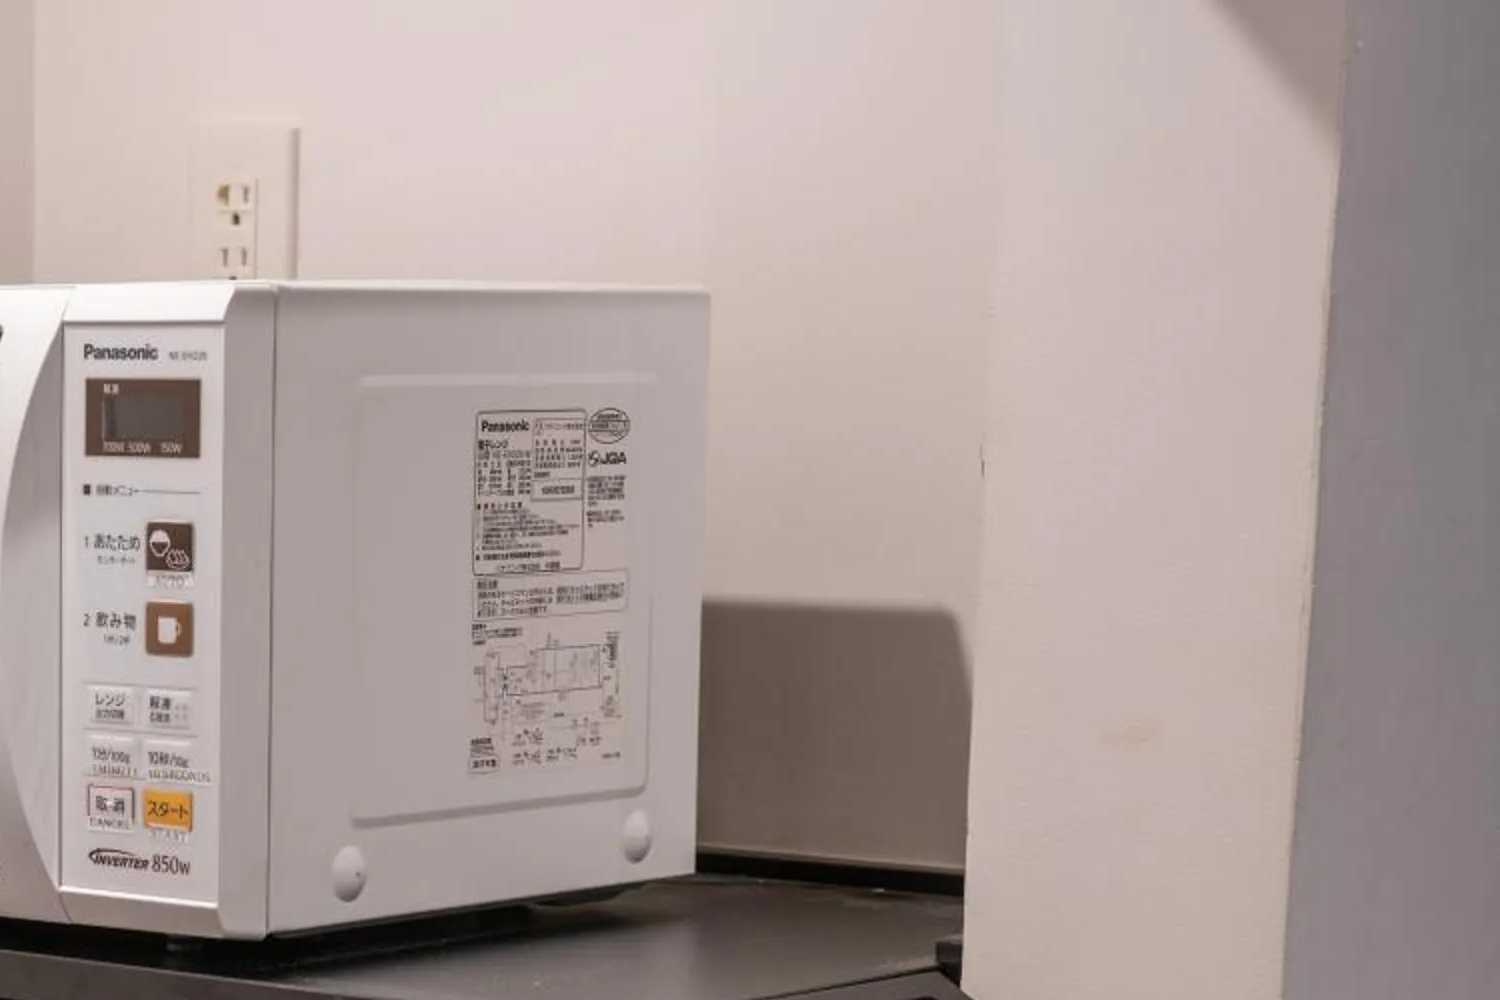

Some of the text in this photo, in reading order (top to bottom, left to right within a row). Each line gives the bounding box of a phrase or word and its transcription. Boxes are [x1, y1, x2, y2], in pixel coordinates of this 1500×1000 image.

[83, 343, 159, 360] Panasonic
[481, 420, 530, 433] Panasonic
[147, 800, 189, 819] スタート
